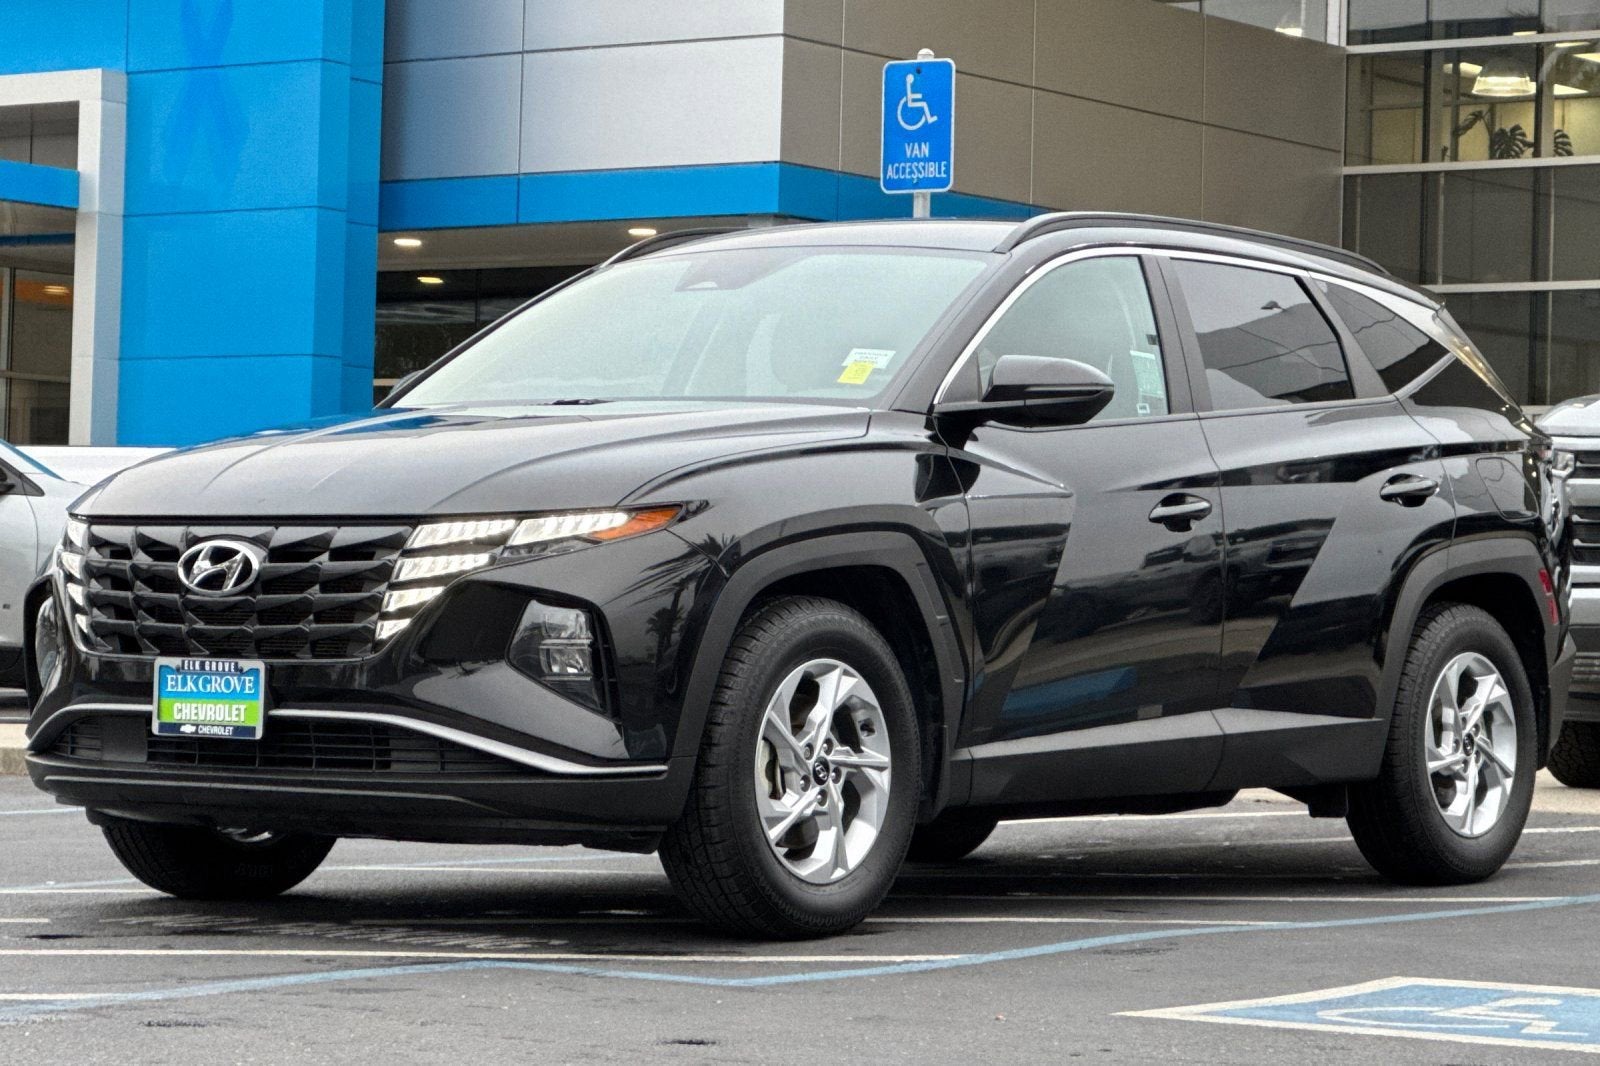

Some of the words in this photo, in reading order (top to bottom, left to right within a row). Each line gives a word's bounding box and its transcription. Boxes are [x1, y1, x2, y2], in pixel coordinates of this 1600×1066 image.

[905, 142, 929, 158] VAN
[886, 161, 947, 180] ACCESSIBLE
[184, 660, 200, 670] ELK
[205, 661, 235, 672] GROVE
[173, 703, 247, 722] CHEVROLET
[198, 726, 233, 736] CHEVROLET
